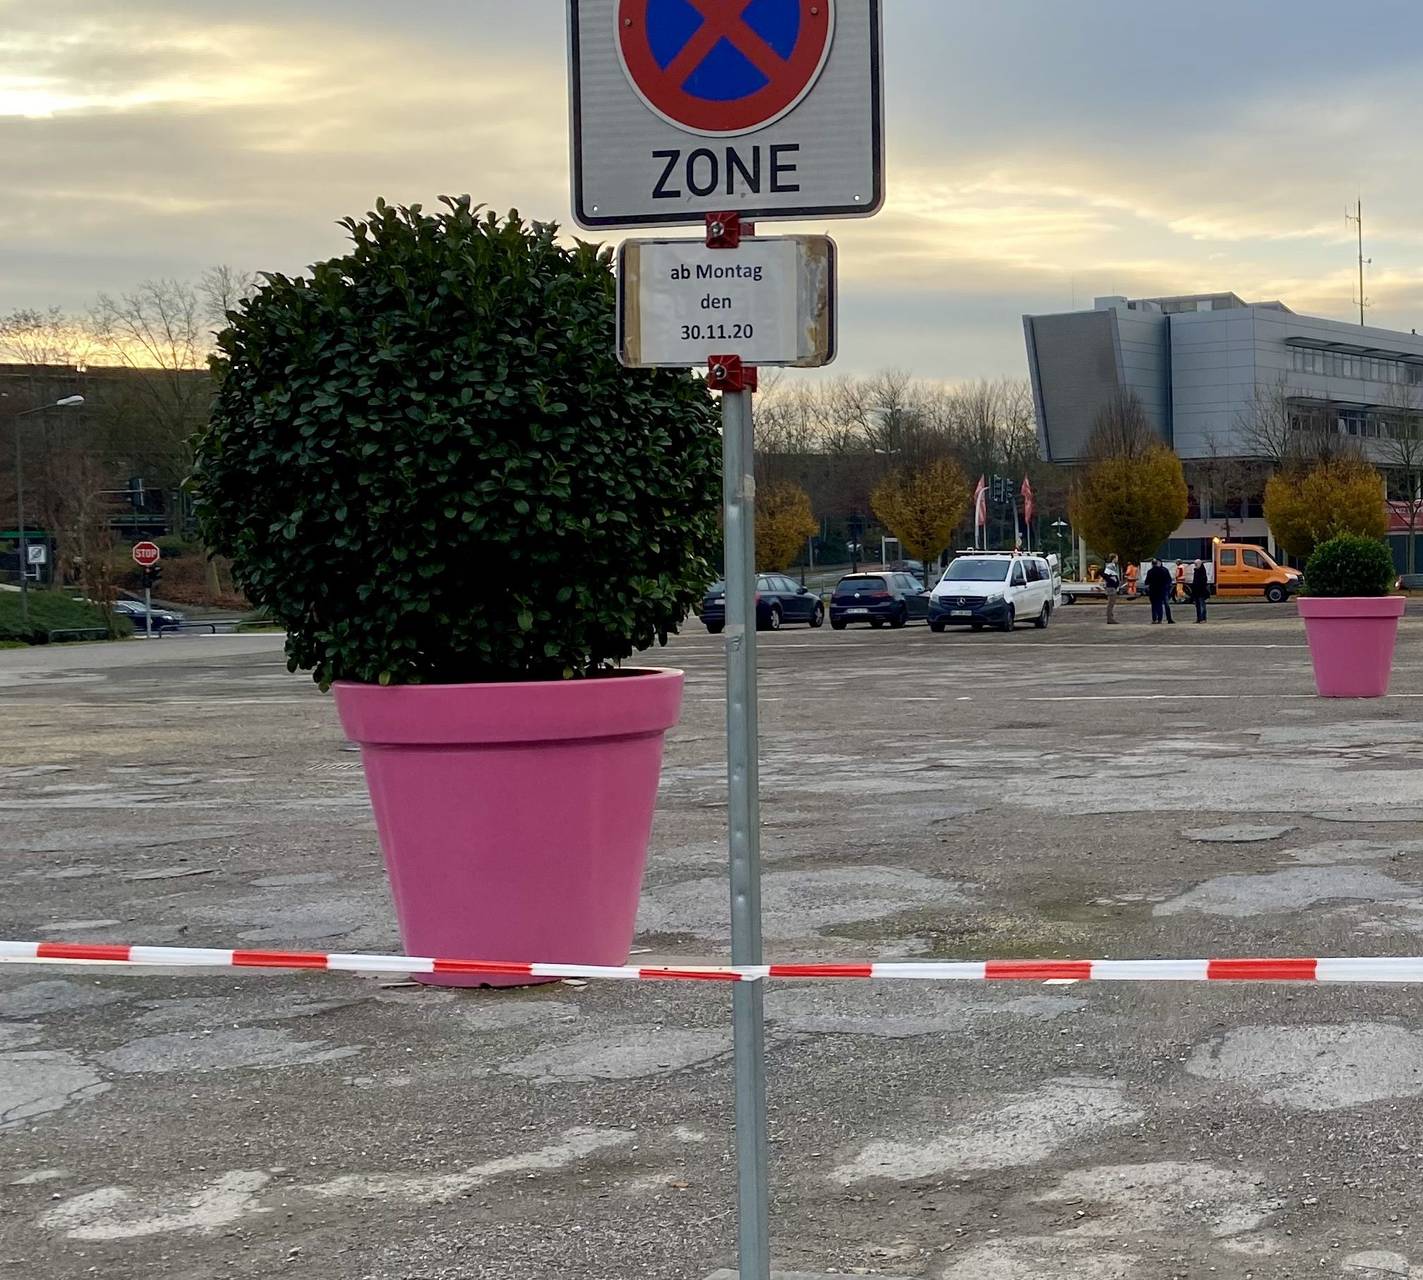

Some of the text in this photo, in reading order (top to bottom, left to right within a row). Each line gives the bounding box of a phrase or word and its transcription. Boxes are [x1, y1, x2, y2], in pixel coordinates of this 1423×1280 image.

[652, 144, 800, 198] ZONE
[670, 264, 763, 281] ab Montag
[700, 293, 732, 309] den
[680, 324, 754, 340] 30.11.20
[135, 549, 157, 558] STOP
